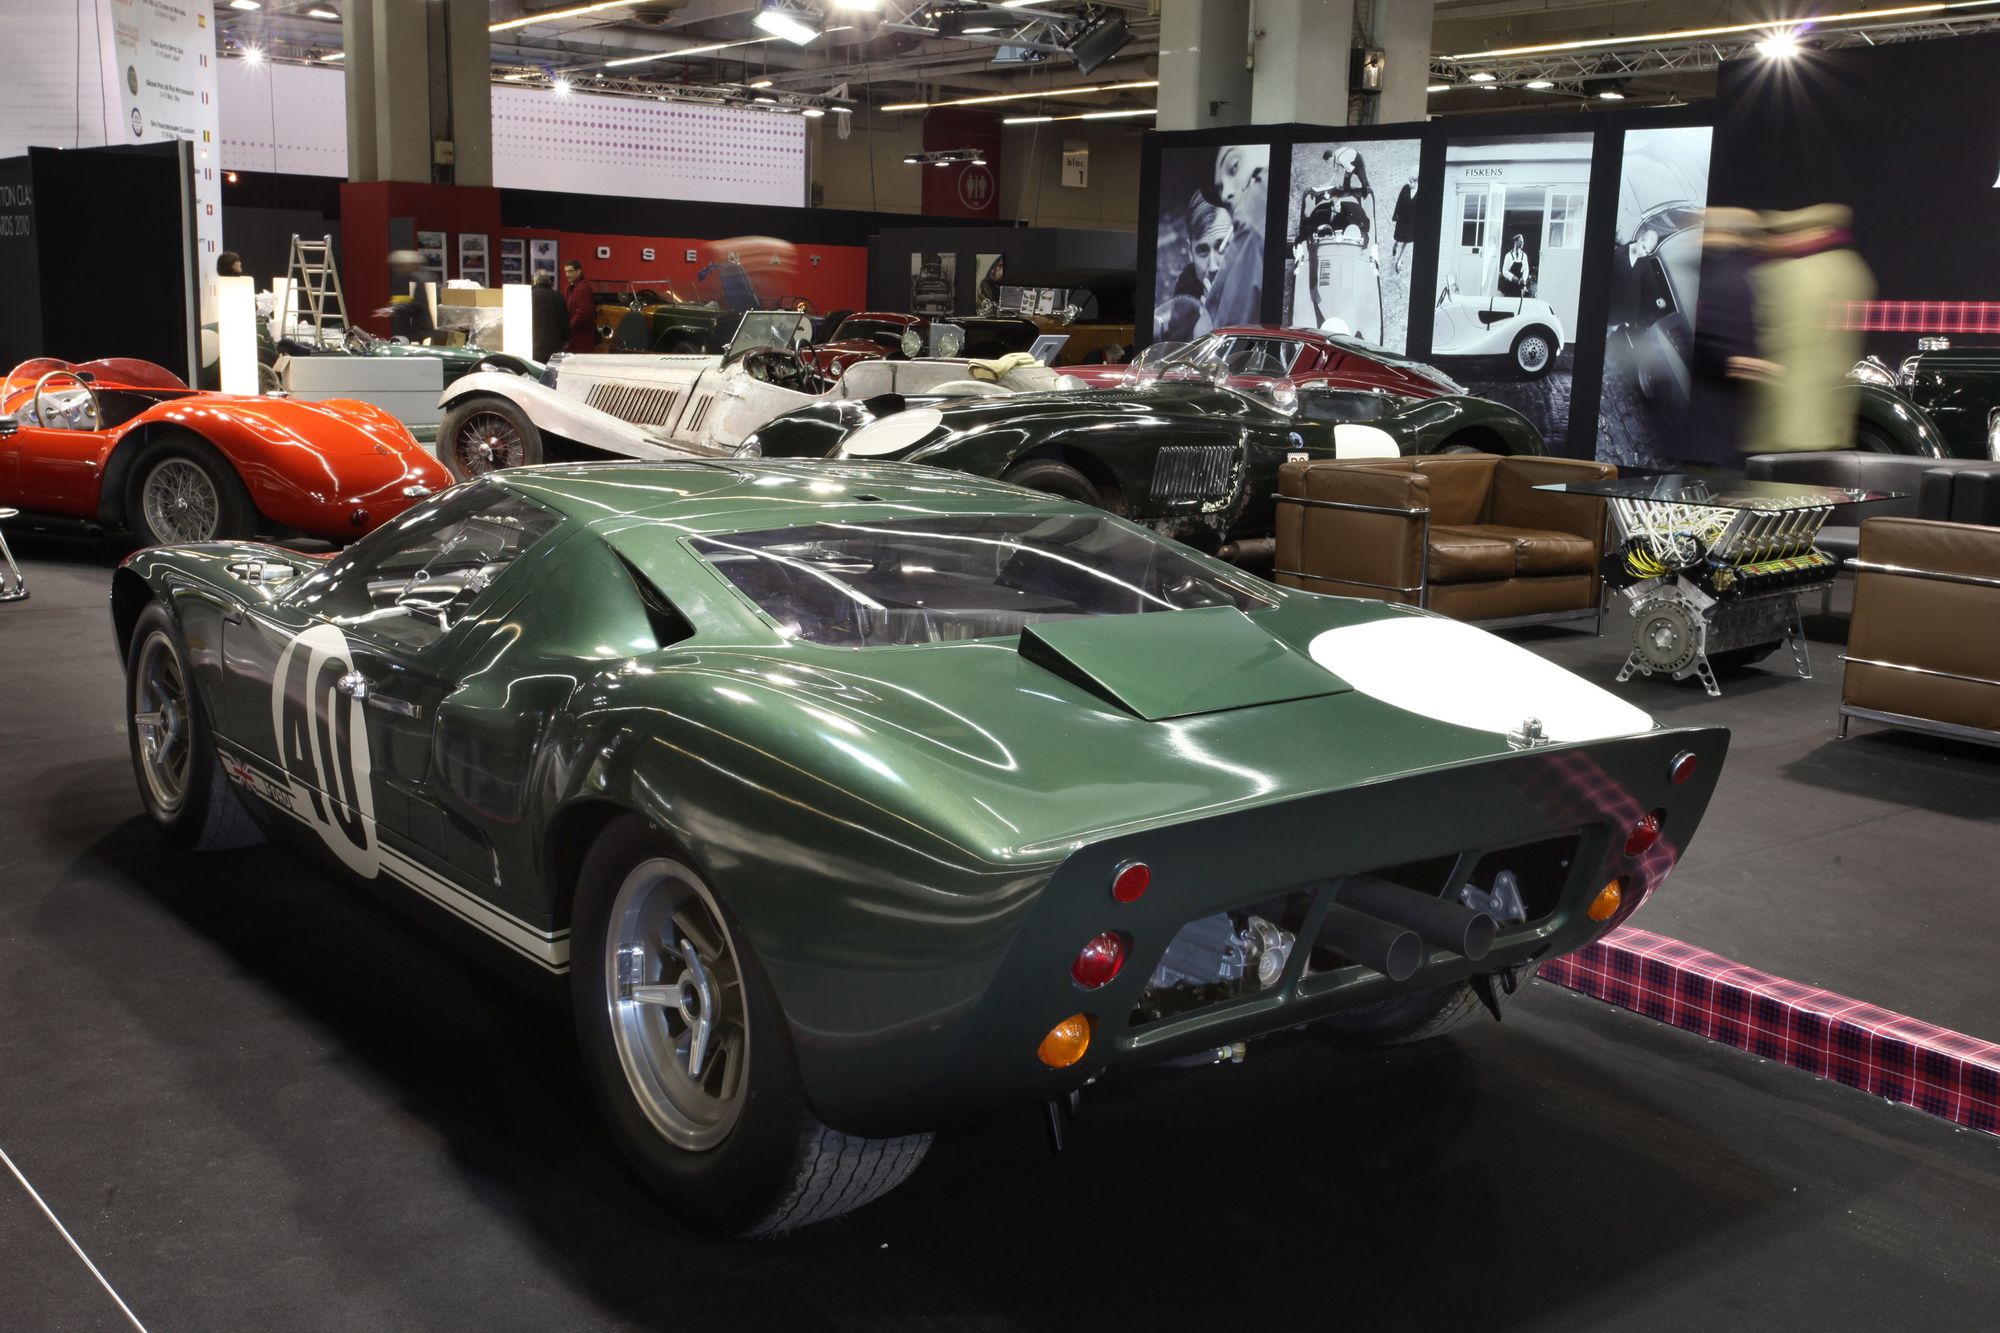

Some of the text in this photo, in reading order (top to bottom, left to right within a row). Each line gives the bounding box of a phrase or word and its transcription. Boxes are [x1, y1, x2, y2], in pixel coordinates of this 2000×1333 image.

[1078, 170, 1084, 185] 1
[1465, 168, 1503, 177] FISKENS
[282, 642, 368, 851] 40
